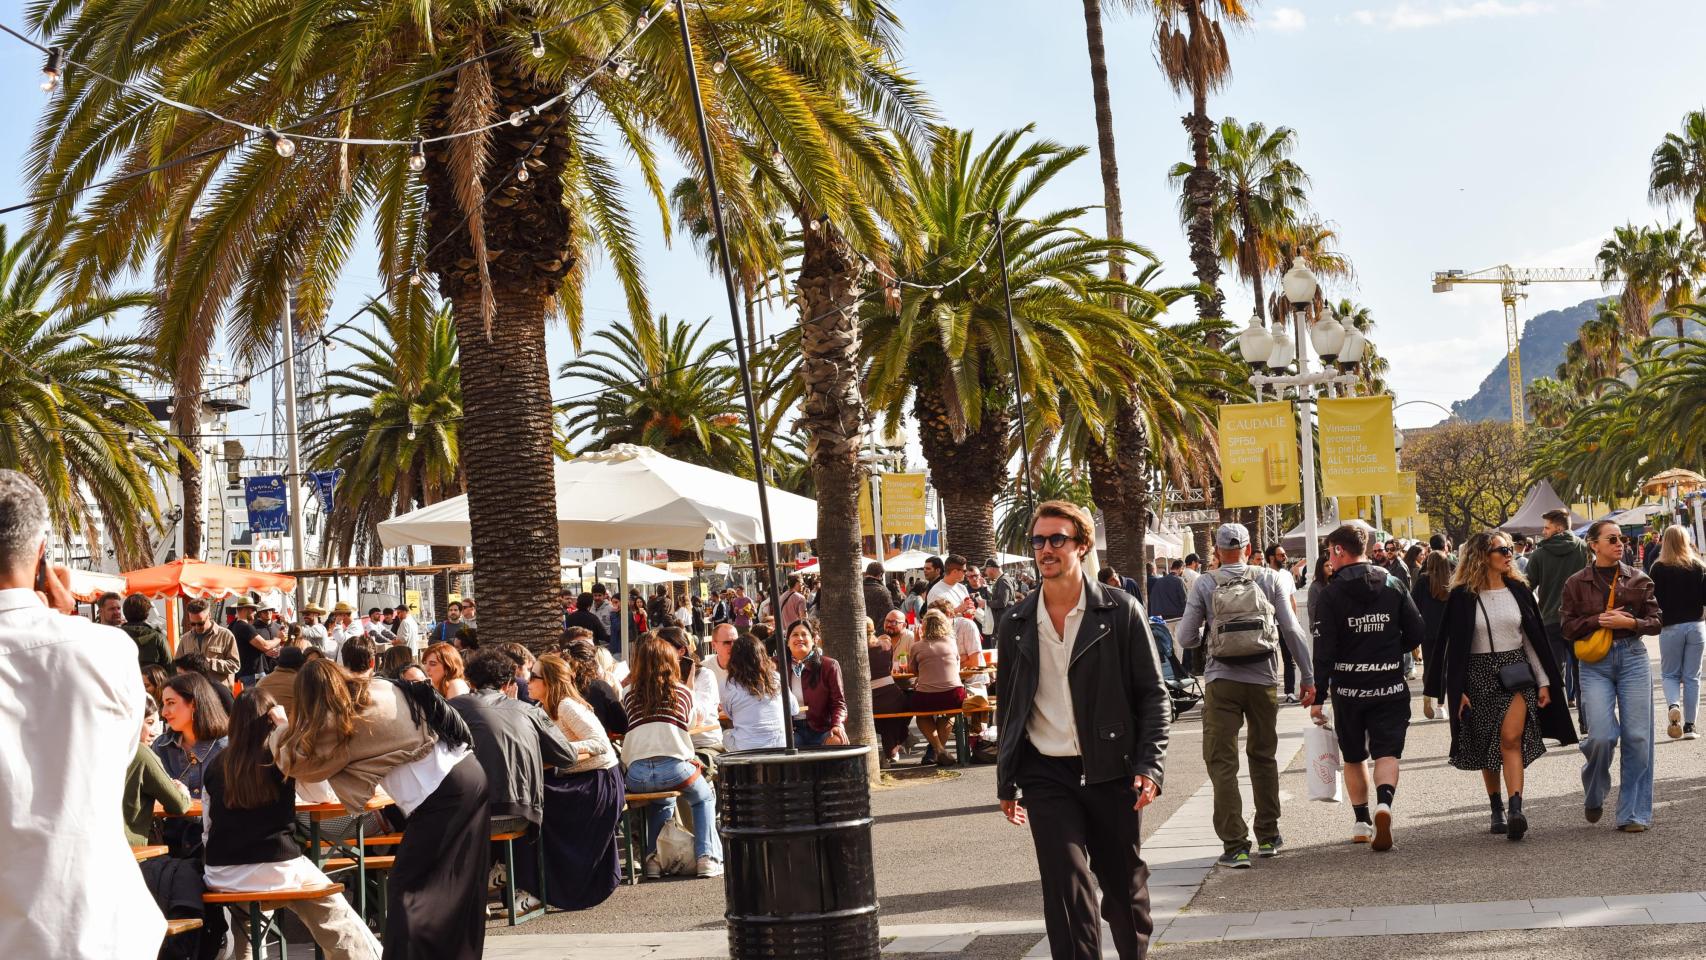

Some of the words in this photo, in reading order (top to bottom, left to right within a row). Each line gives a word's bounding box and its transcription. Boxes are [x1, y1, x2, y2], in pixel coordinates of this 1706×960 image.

[1228, 437, 1256, 447] SPF50
[1328, 456, 1343, 464] ALL
[1345, 454, 1377, 464] THOSE
[1348, 613, 1390, 627] Emirates
[1363, 623, 1385, 633] BETTER
[1334, 662, 1354, 672] NEW
[1355, 661, 1399, 672] ZEALAND
[1336, 687, 1358, 698] NEW
[1358, 682, 1404, 698] ZEALAND
